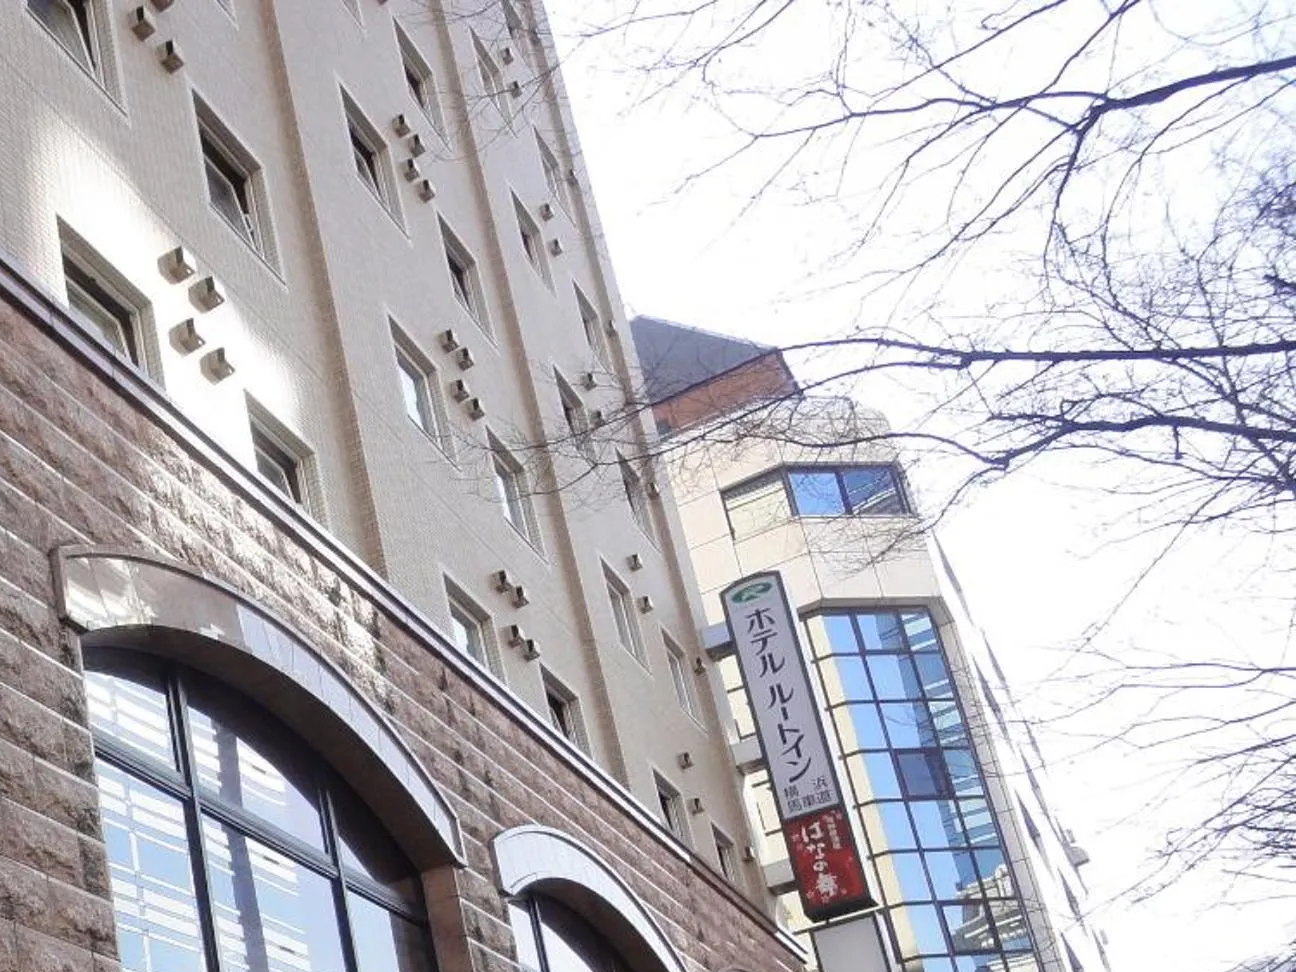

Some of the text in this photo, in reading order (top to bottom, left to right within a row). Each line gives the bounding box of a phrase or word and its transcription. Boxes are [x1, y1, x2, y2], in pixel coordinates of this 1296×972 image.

[746, 607, 812, 784] ホテル ルートイン
